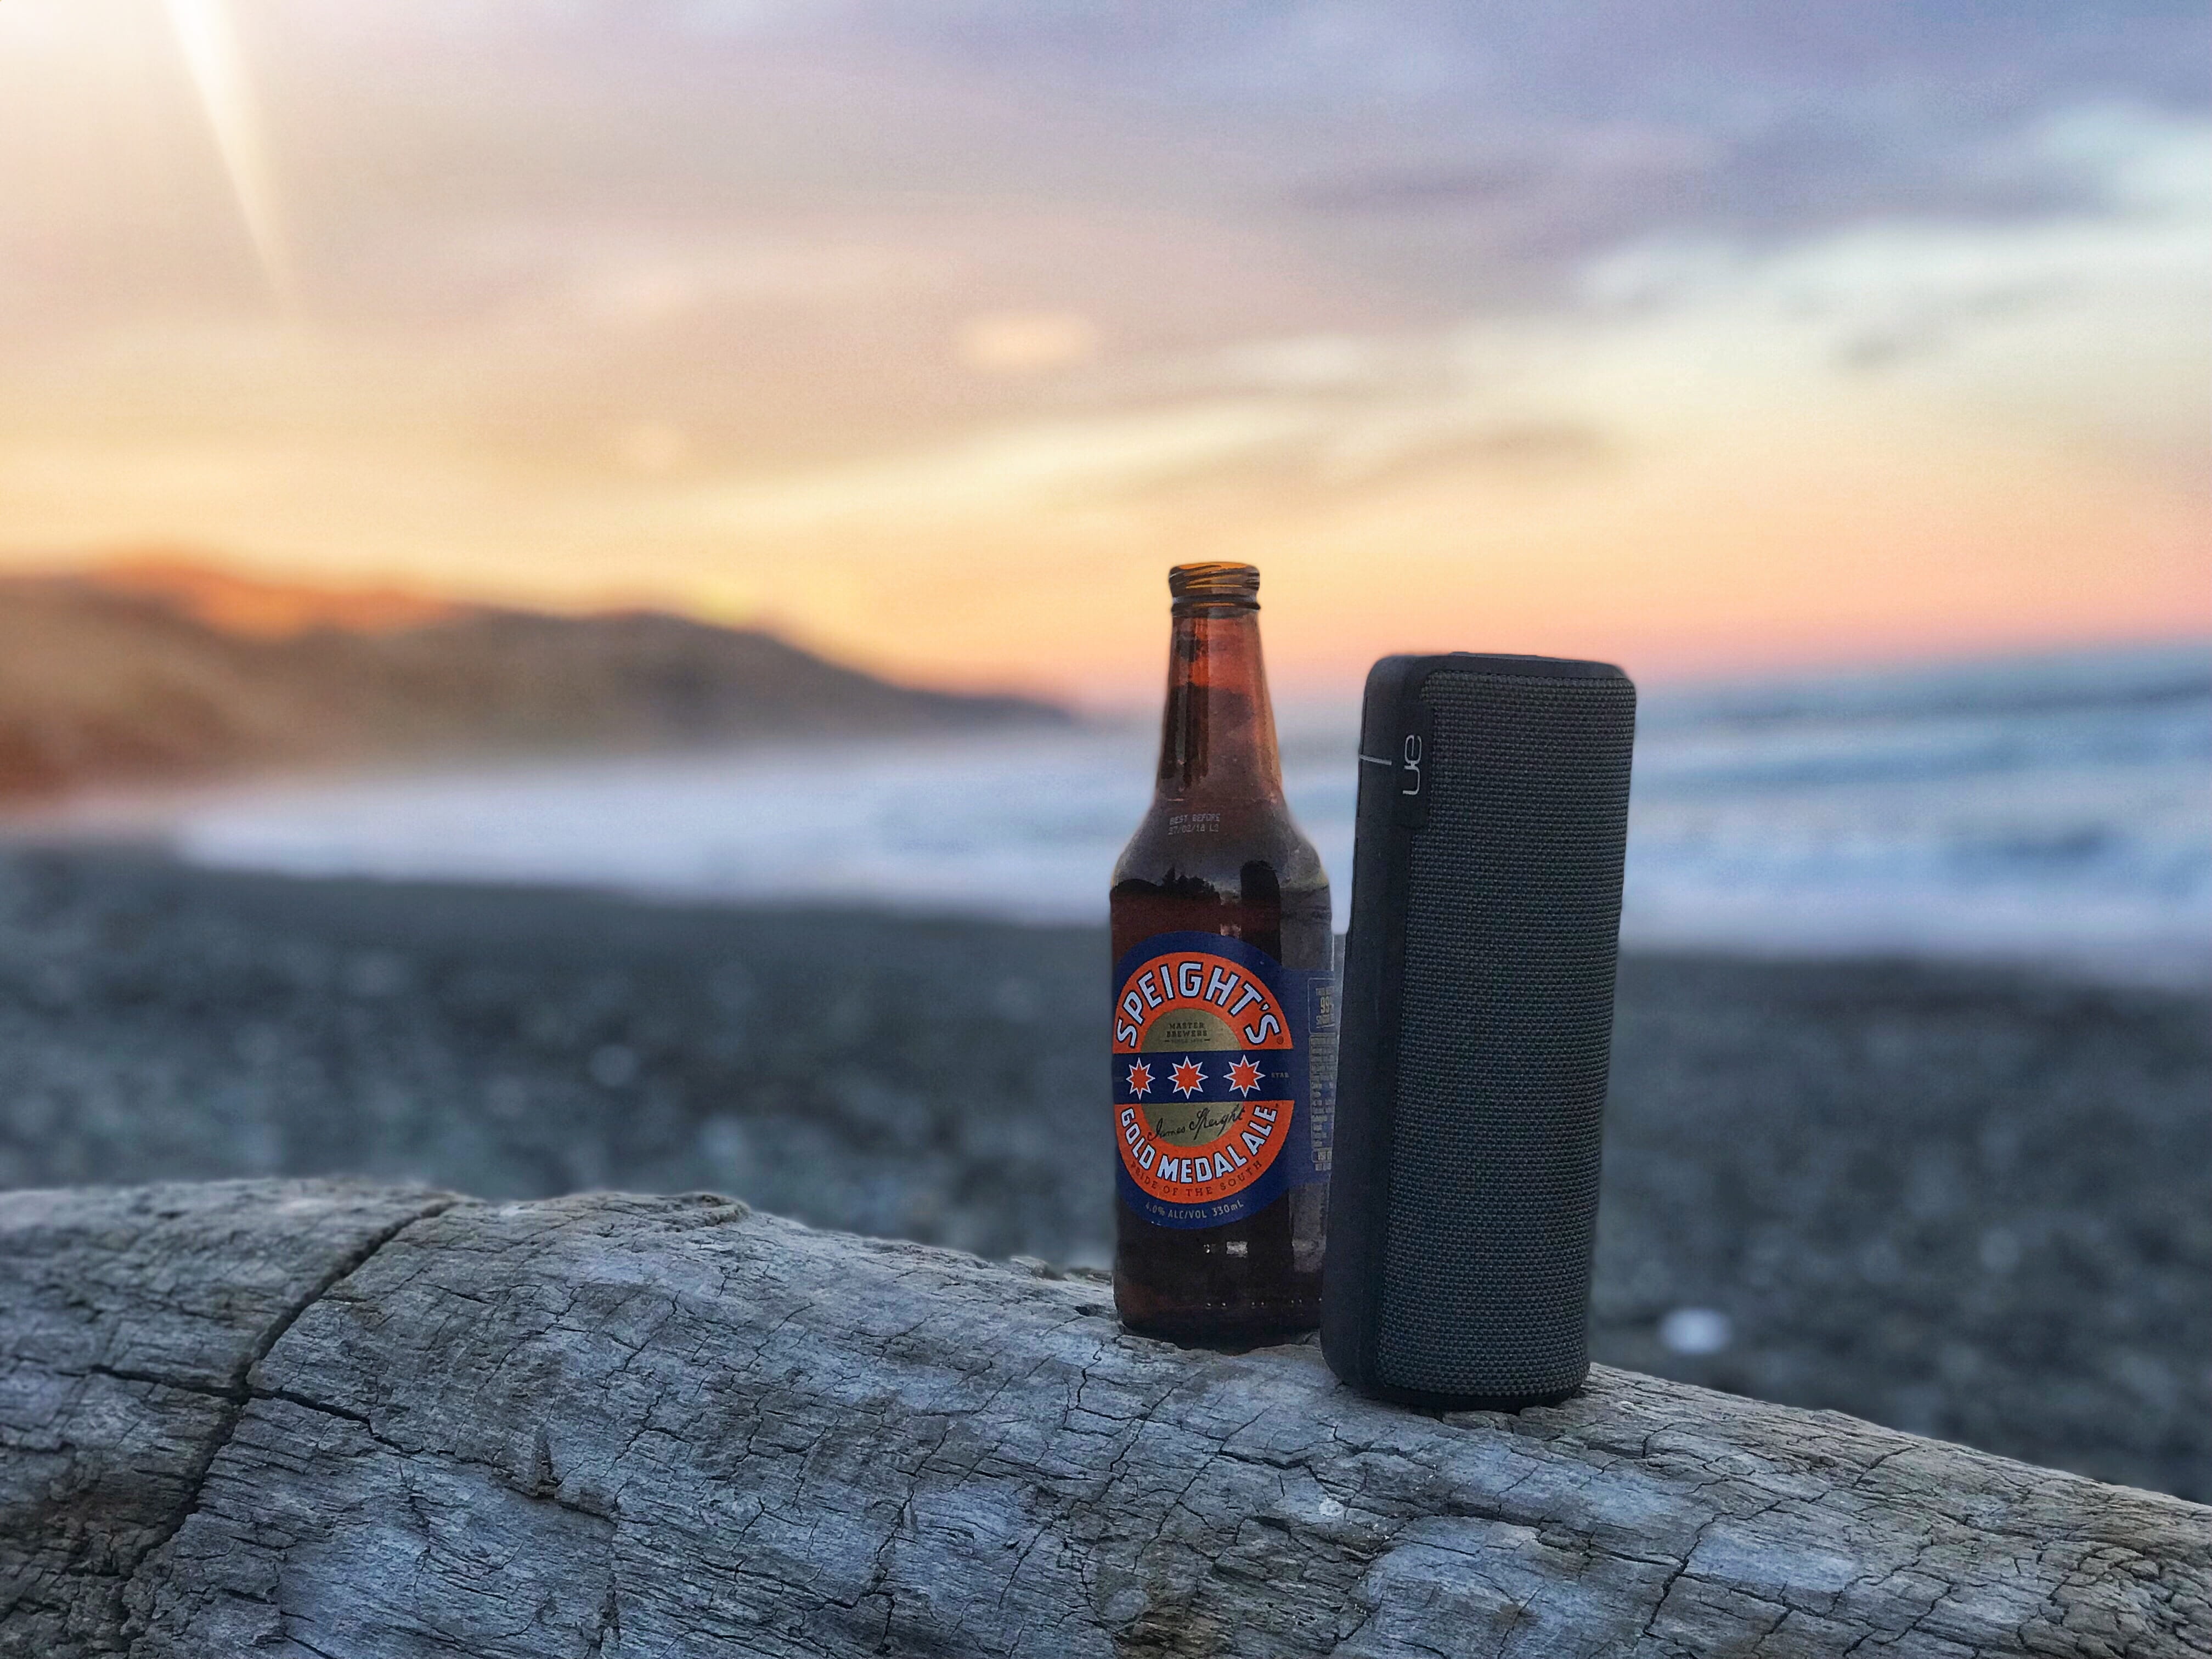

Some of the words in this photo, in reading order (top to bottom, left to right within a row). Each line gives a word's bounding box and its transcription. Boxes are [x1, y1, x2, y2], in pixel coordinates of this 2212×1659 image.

[1169, 814, 1188, 825] BEST
[1192, 813, 1221, 822] BEFORE
[1116, 961, 1280, 1049] SPEIGHT'S
[1166, 1030, 1207, 1038] BREWERS
[1120, 1107, 1155, 1170] GOLD
[1156, 1143, 1248, 1184] MEDAL
[1240, 1104, 1278, 1156] ALE
[1130, 1161, 1158, 1189] PRIDE
[1163, 1185, 1178, 1197] OF
[1186, 1186, 1212, 1197] THE
[1220, 1160, 1262, 1191] SOUTH
[1167, 1209, 1207, 1220] ALC/VOL
[1212, 1199, 1244, 1216] 330mL
